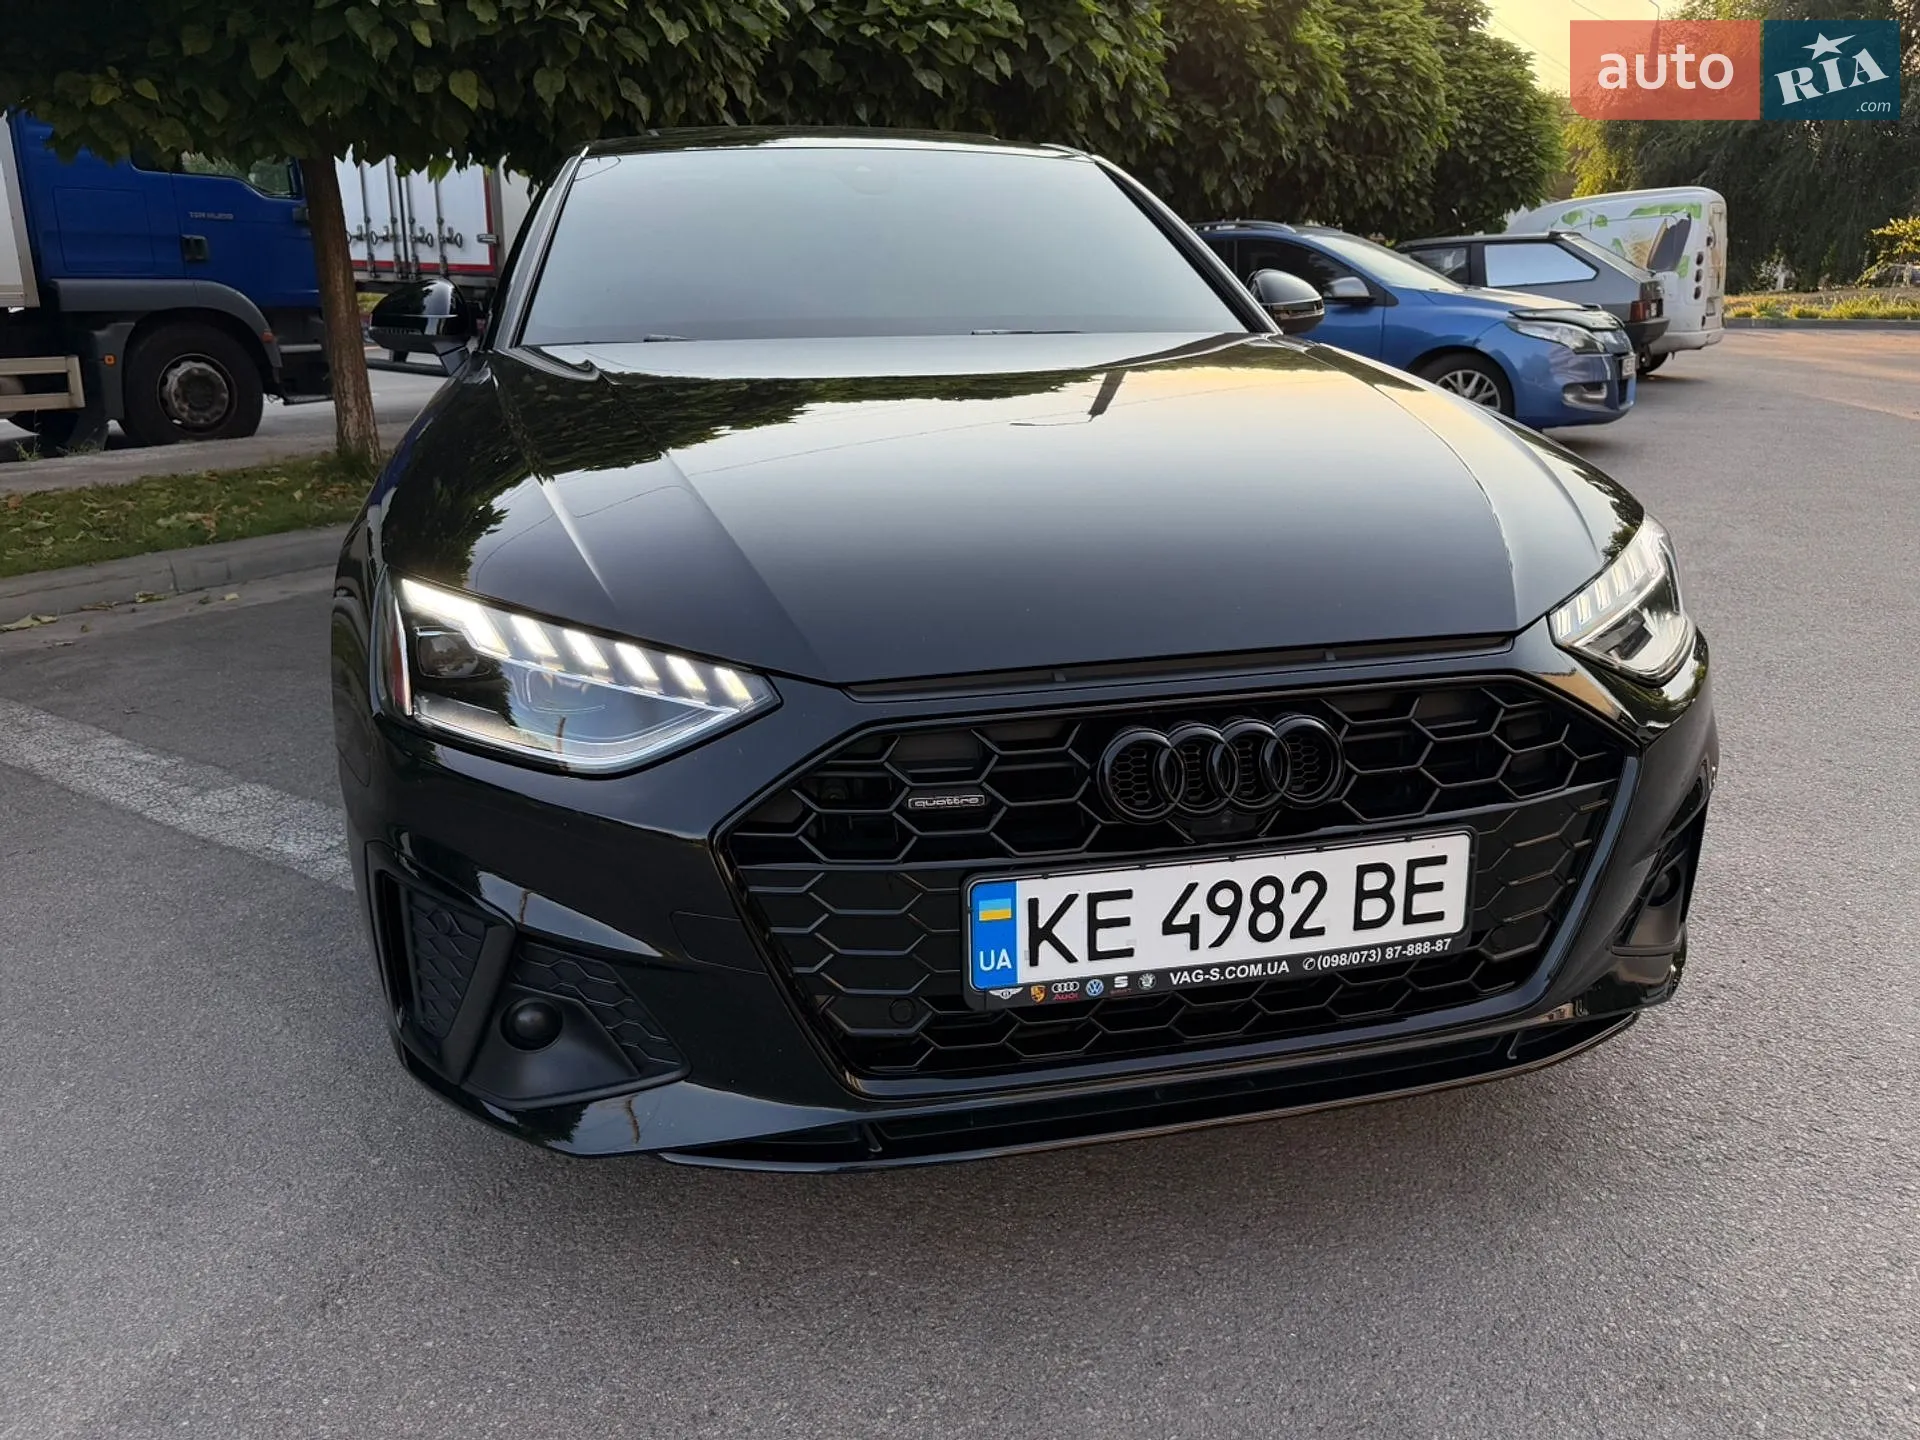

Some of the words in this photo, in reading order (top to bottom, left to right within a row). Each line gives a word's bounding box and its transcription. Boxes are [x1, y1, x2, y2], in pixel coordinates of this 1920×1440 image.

[914, 797, 980, 809] quattro
[1028, 889, 1134, 966] KE
[1161, 870, 1328, 951] 4982
[1353, 854, 1448, 931] BE
[979, 950, 1011, 971] UA
[1169, 961, 1289, 985] VAG-S.COM.UA
[1317, 948, 1381, 970] (098/073)
[1385, 937, 1452, 960] 87-888-87
